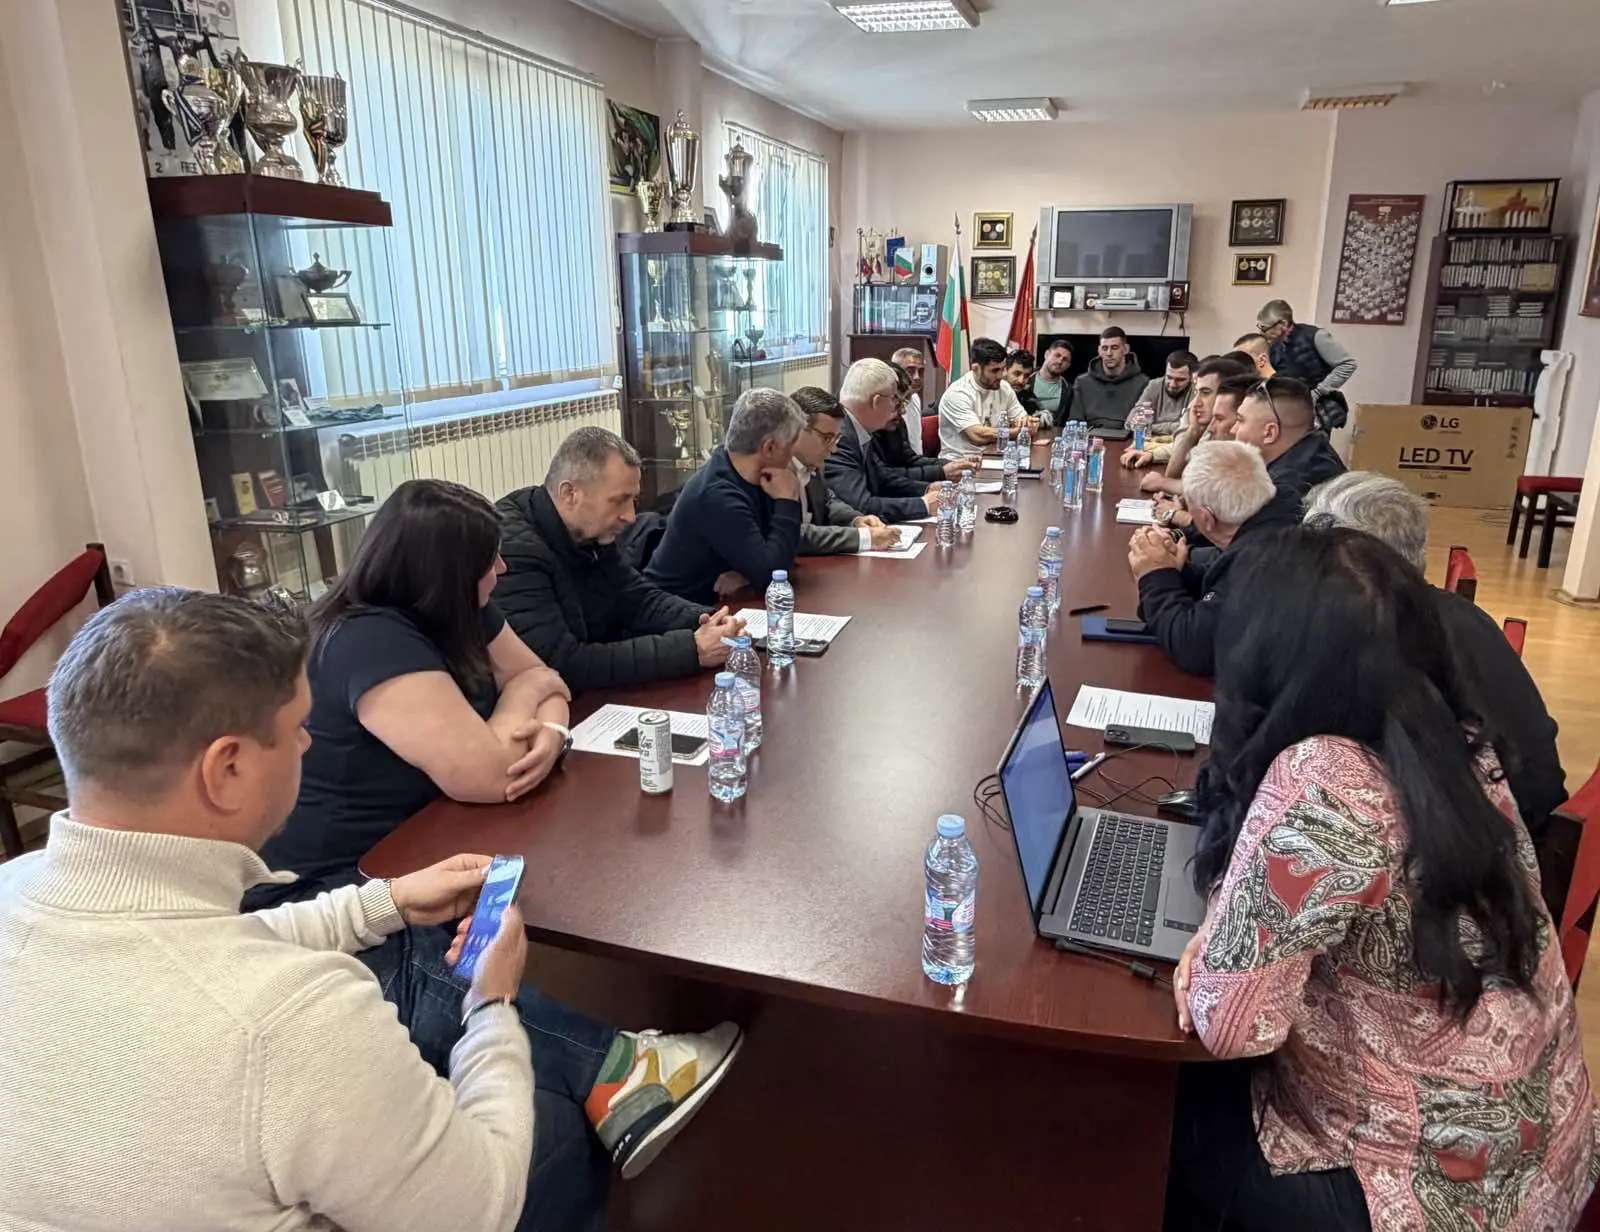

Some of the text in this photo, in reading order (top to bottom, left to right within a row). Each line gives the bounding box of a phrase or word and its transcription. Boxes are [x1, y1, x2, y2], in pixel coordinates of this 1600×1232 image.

[1440, 417, 1460, 429] LG
[1399, 447, 1475, 465] LED TV
